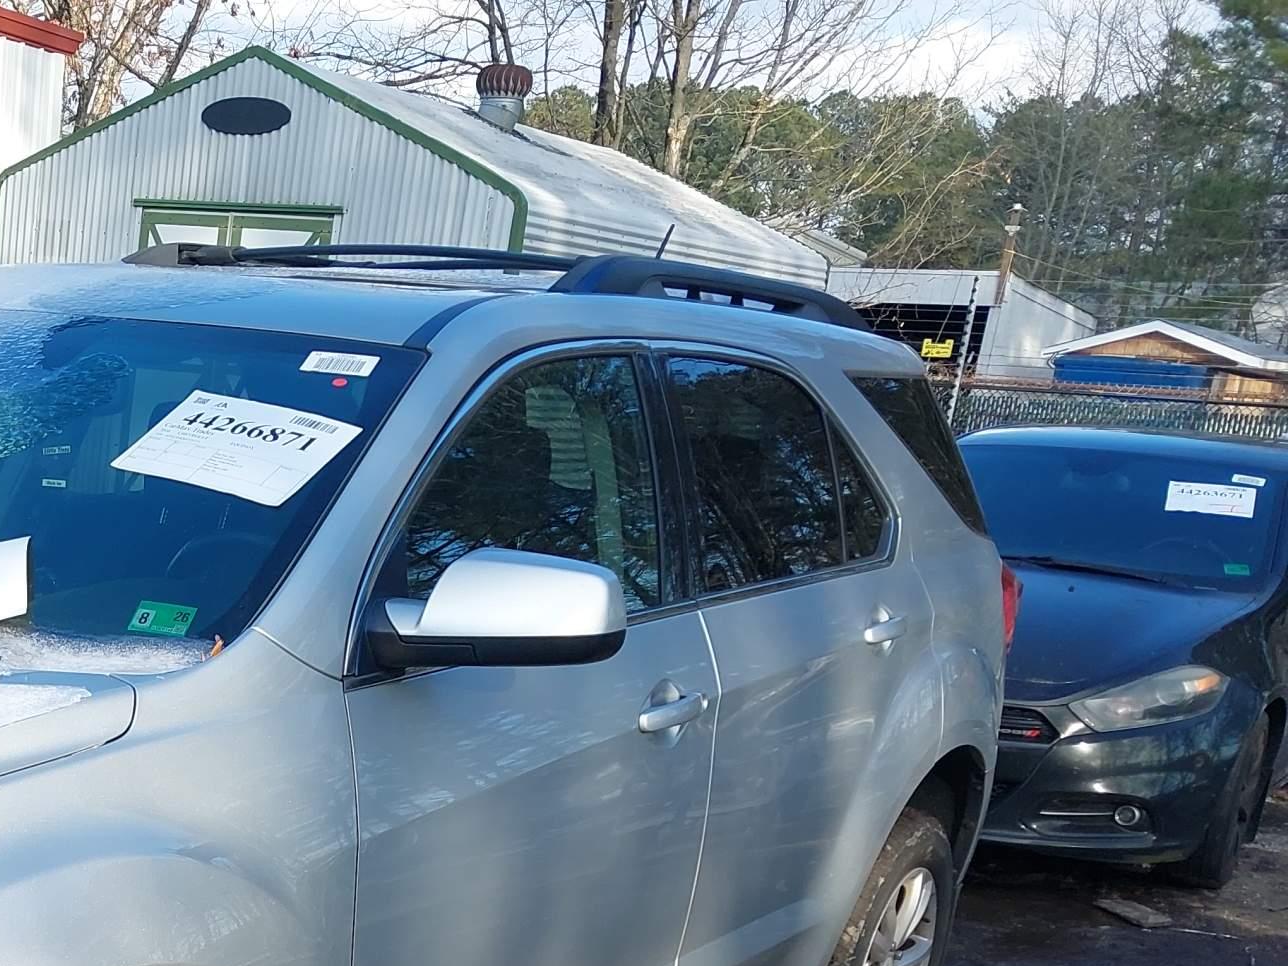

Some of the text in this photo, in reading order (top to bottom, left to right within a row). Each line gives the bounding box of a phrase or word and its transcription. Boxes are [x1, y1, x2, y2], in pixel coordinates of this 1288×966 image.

[183, 412, 317, 452] 44266871
[138, 611, 190, 625] 8 26
